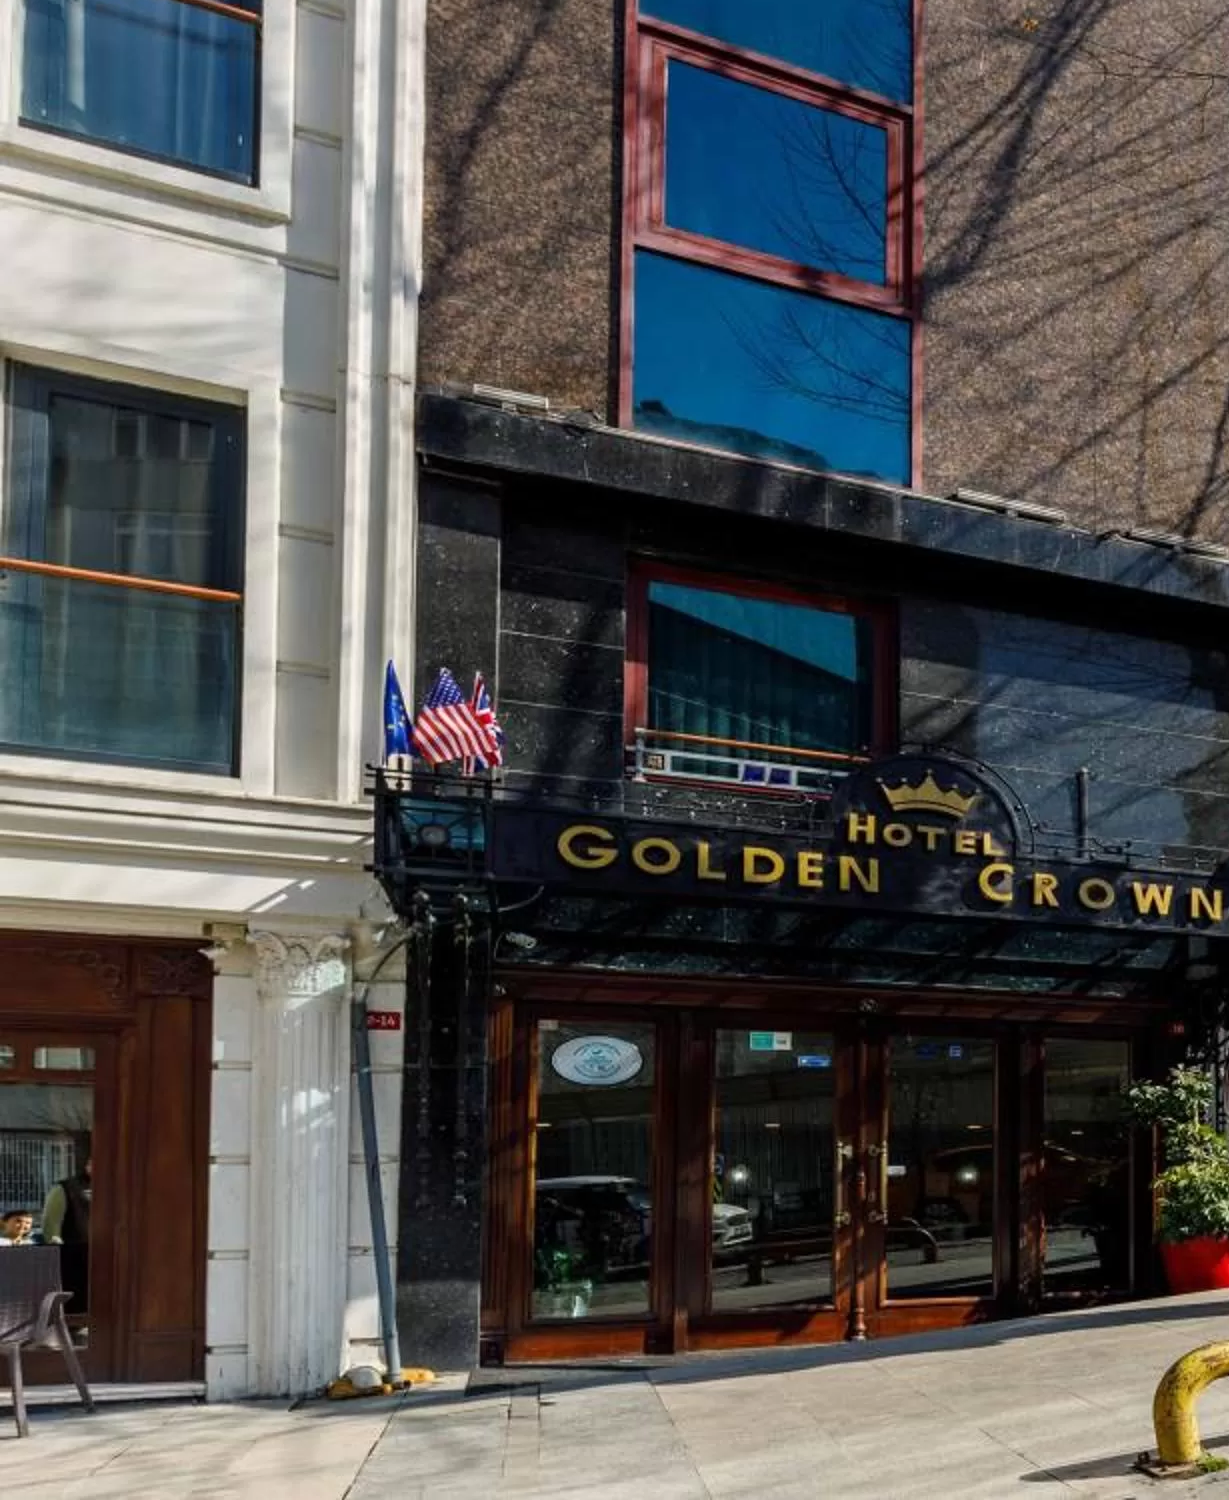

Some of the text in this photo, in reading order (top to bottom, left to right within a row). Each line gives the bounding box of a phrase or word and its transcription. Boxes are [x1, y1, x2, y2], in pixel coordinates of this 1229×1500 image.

[848, 812, 1007, 857] HOTEL
[557, 824, 1223, 921] GOLDEN CROWN
